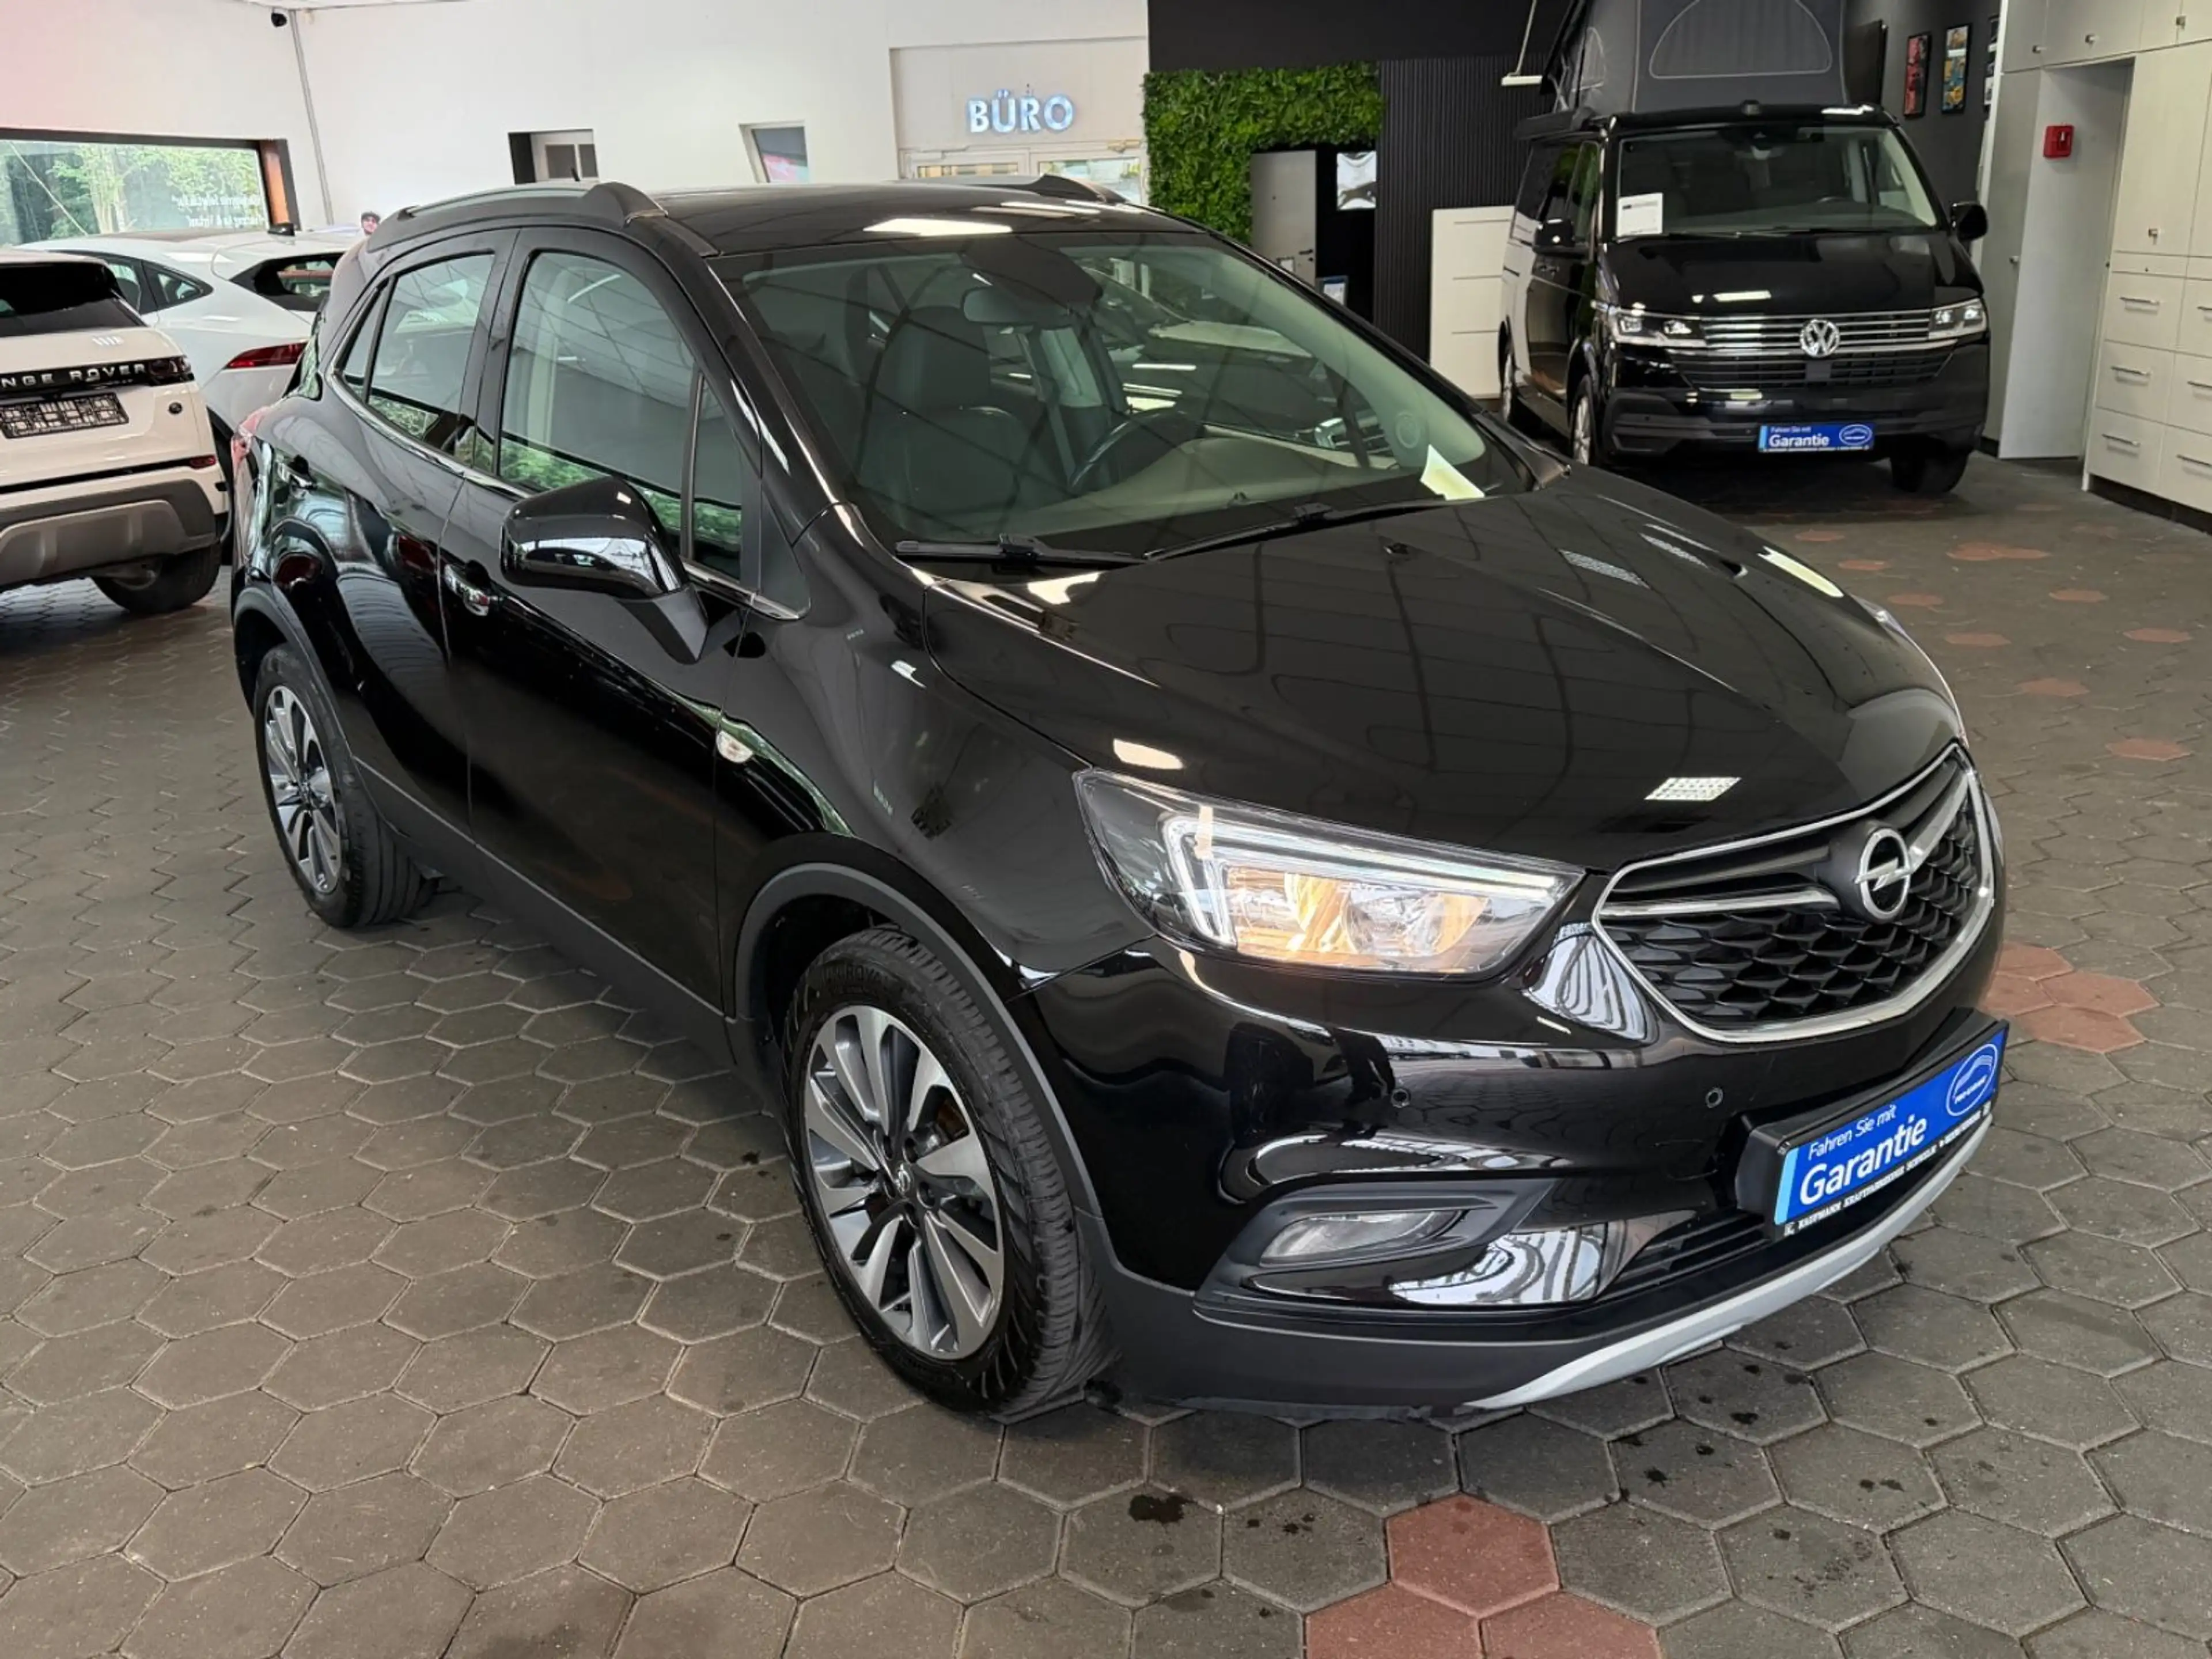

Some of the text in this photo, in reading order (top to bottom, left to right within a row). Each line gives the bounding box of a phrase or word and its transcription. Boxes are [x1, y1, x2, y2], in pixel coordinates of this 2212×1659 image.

[969, 89, 1074, 133] BÜRO
[1800, 319, 1839, 357] VW
[69, 363, 146, 382] ROVER
[1768, 433, 1830, 448] Garantie
[1808, 1104, 1896, 1161] Fahren Sie mit
[1800, 1113, 1927, 1205] Garantie
